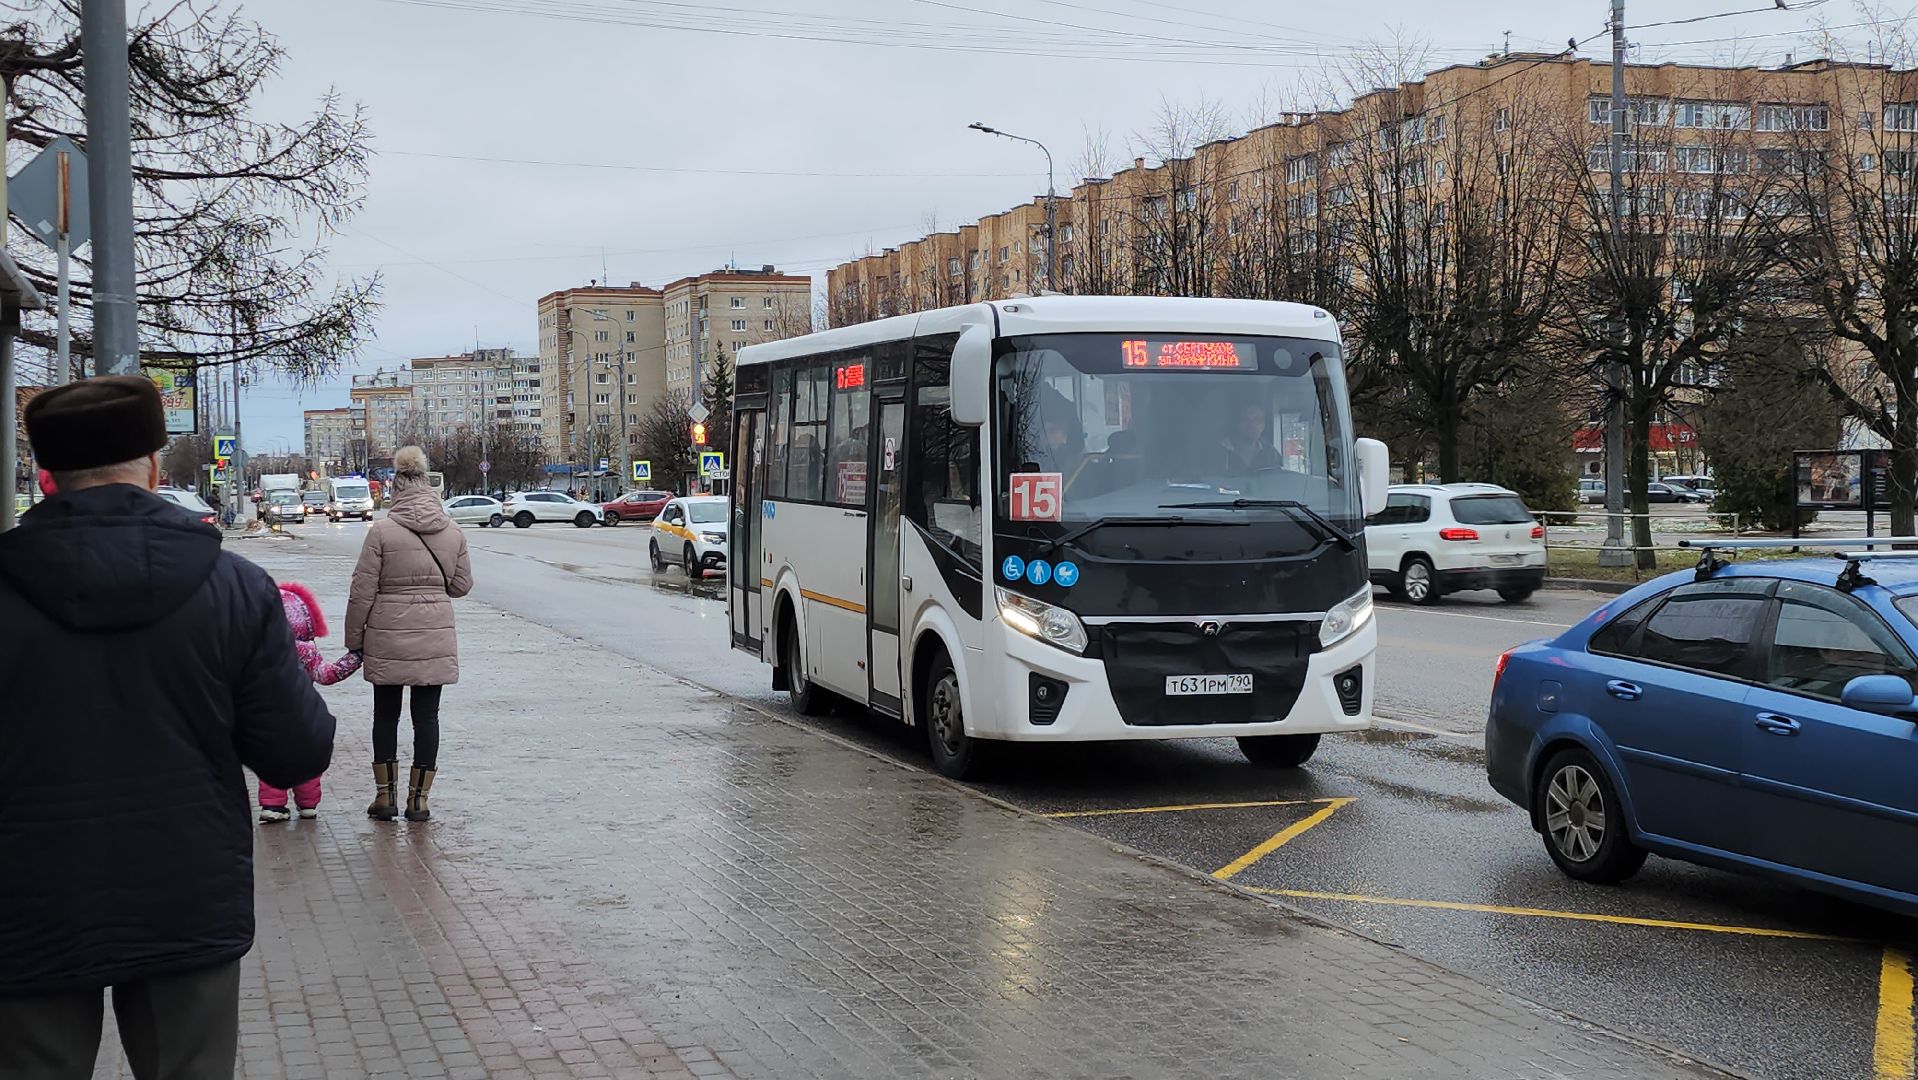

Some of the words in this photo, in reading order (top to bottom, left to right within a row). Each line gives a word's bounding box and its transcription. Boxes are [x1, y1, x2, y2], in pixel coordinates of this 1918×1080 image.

[1122, 340, 1147, 365] 15
[713, 470, 730, 478] СТО
[1014, 480, 1056, 518] 15
[1171, 677, 1227, 693] Т631РМ
[1229, 675, 1251, 687] 790
